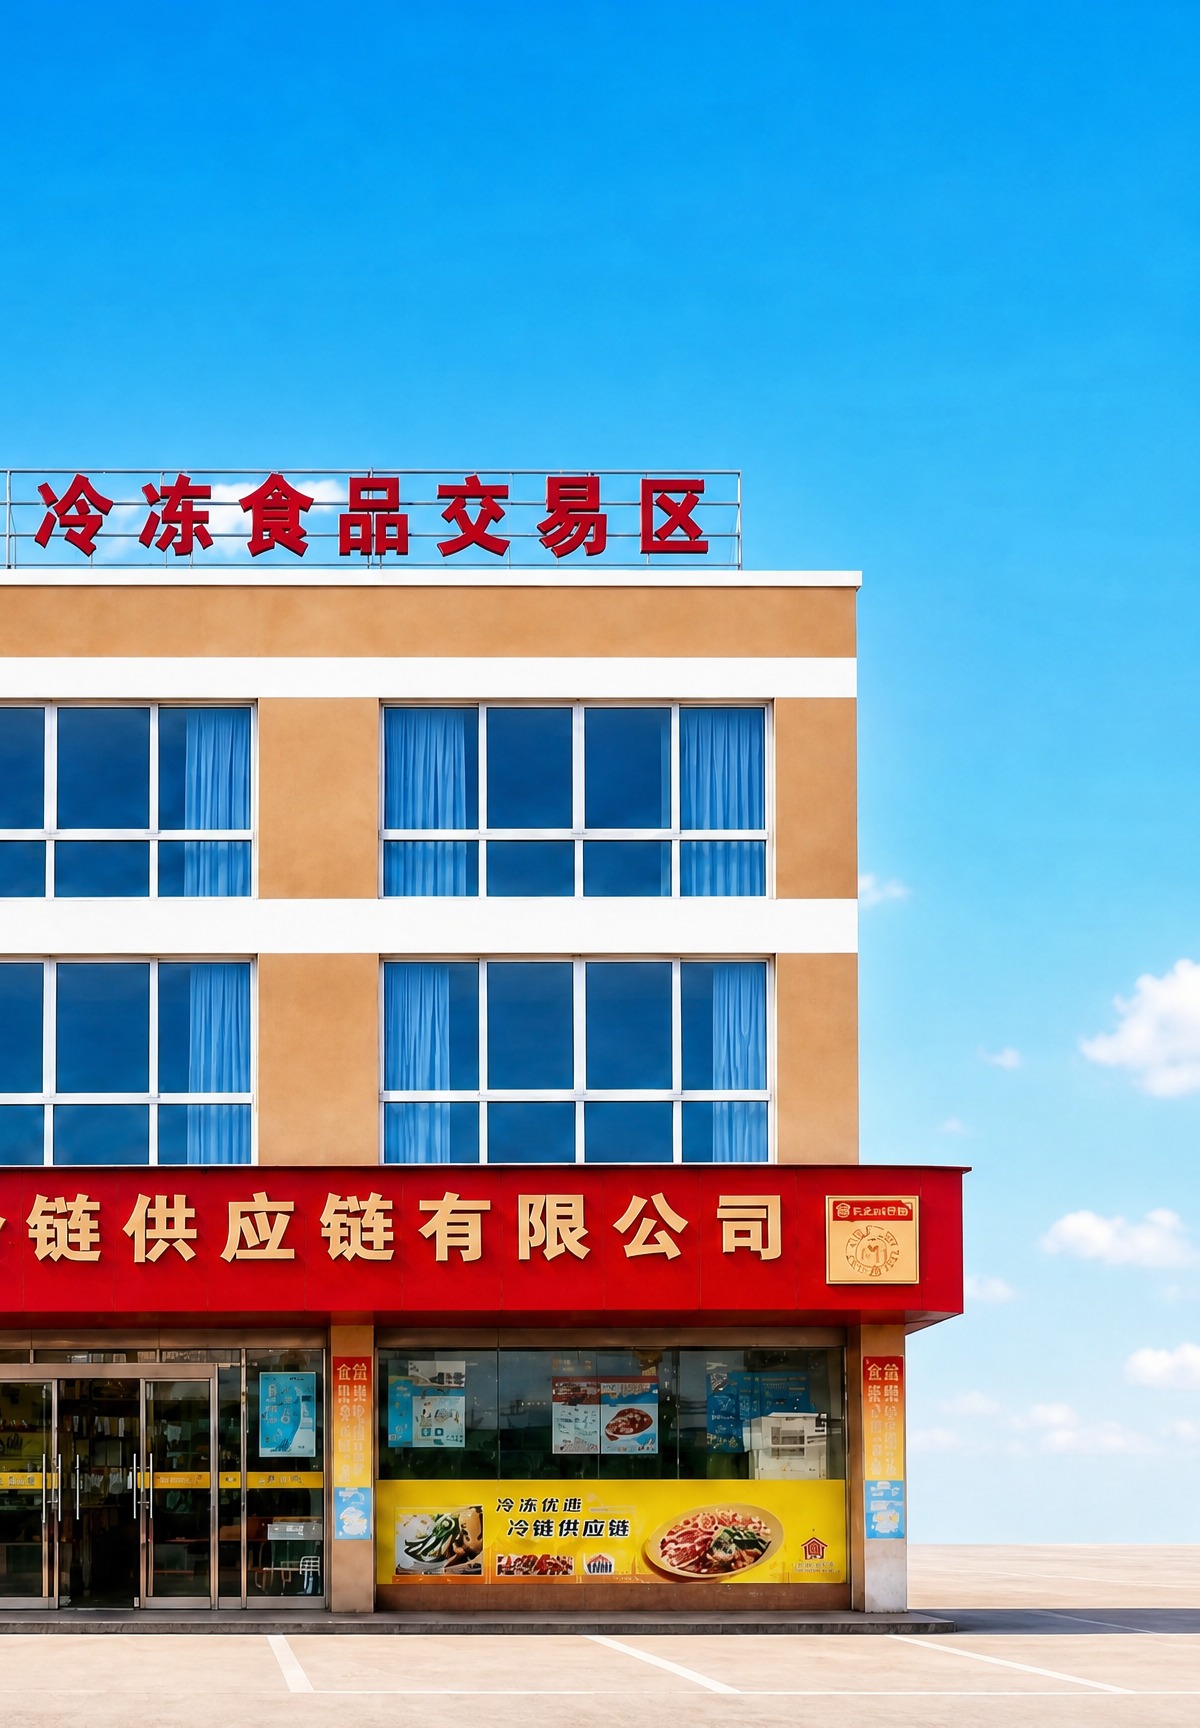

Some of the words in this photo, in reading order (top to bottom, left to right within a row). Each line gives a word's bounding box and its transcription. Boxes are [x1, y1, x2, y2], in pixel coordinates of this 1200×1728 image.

[34, 473, 709, 557] 冷冻食品交易区
